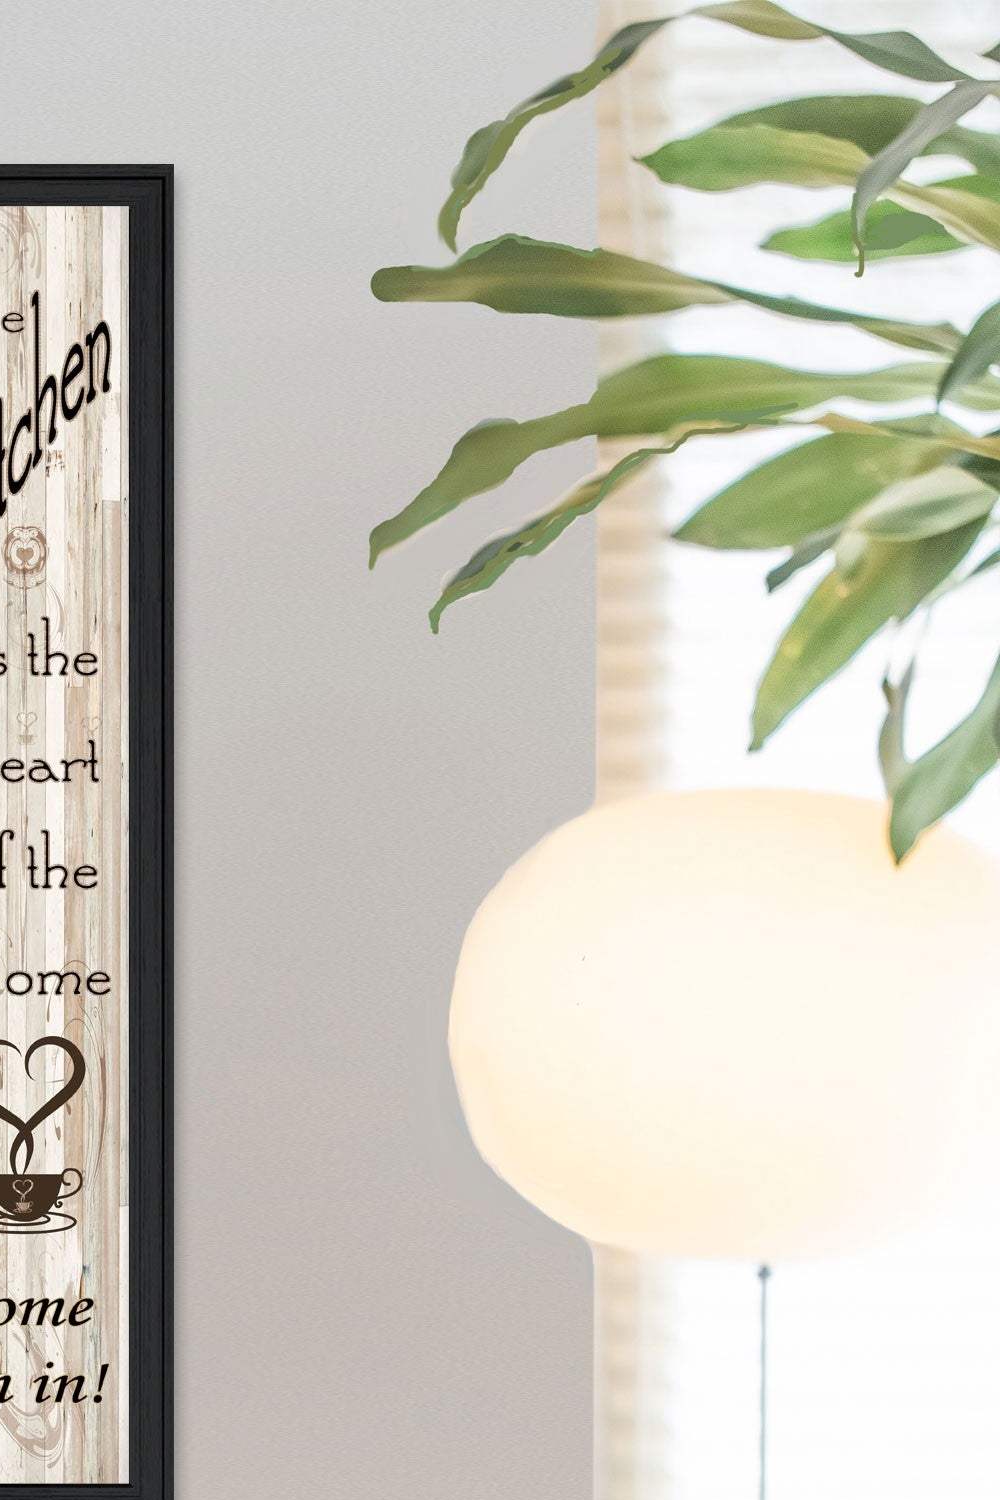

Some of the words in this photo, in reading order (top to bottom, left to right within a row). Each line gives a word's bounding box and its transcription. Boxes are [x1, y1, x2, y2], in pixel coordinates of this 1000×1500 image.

[27, 616, 98, 676] the
[27, 829, 98, 889] the
[33, 1361, 110, 1404] in!
